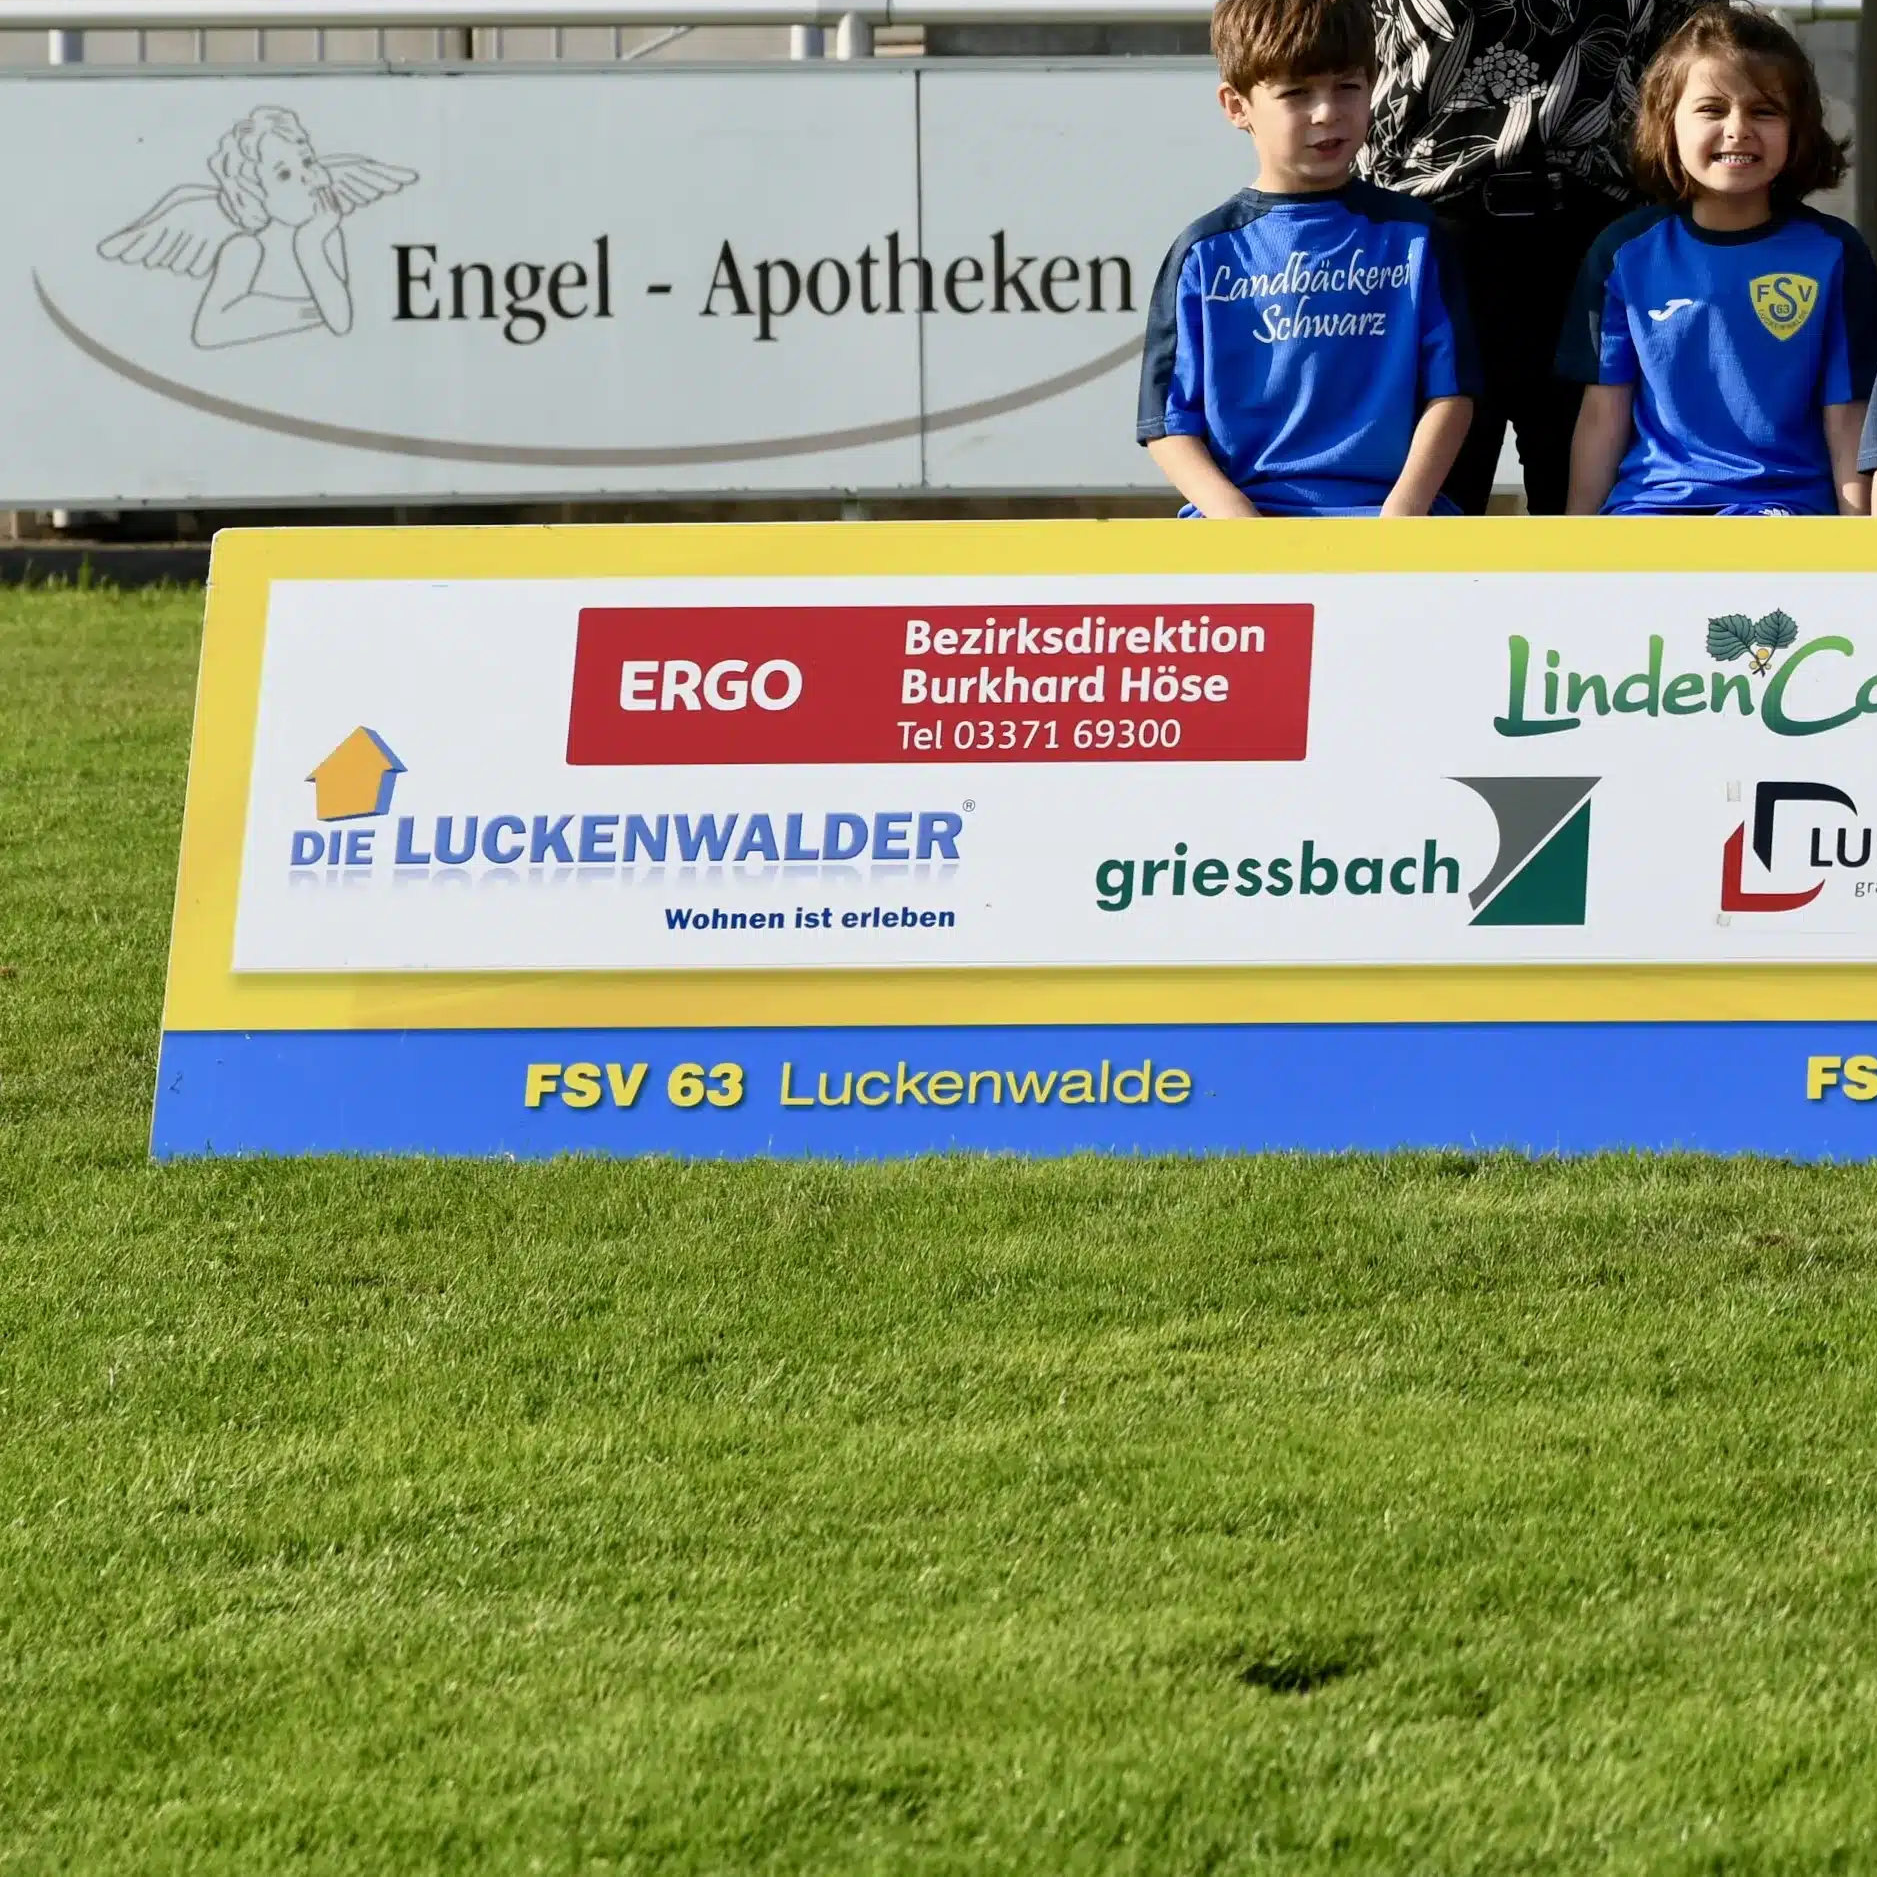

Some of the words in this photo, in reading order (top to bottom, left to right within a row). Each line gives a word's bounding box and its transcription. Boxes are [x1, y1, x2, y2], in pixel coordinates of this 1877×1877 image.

[392, 235, 613, 344] Engel
[647, 285, 672, 294] -
[699, 227, 1136, 345] Apotheken
[1205, 248, 1412, 303] Landbäckerei
[1252, 295, 1386, 344] Schwarz
[1757, 277, 1813, 323] FSV
[905, 616, 1264, 655] Bezirksdirektion
[620, 659, 802, 711] ERGO
[902, 665, 1104, 704] Burkhard
[1121, 665, 1228, 702] Höse
[897, 720, 942, 750] Tel
[954, 721, 1059, 749] 03371
[1074, 719, 1180, 748] 69300
[291, 830, 375, 865] DIE
[1096, 839, 1459, 911] griessbach
[665, 908, 784, 929] Wohnen
[795, 907, 832, 928] ist
[842, 907, 954, 928] erleben
[525, 1062, 649, 1110] FSV
[667, 1062, 746, 1109] 63
[780, 1059, 1193, 1109] Luckenwalde
